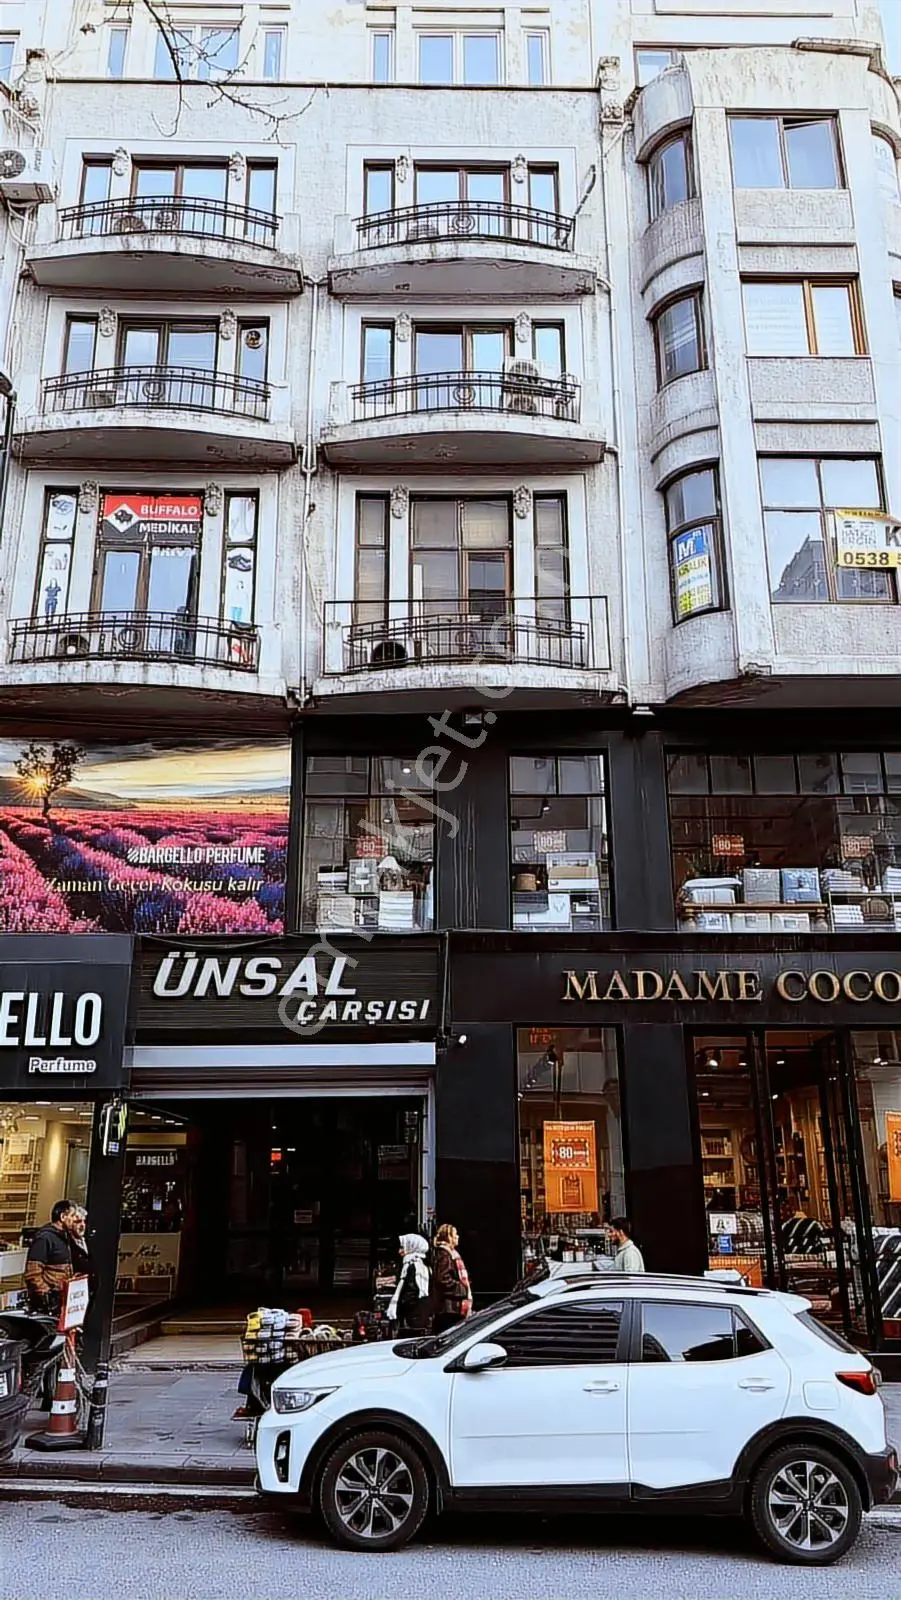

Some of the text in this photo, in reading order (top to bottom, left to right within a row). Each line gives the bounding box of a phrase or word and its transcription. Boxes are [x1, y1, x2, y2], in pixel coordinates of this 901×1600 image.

[140, 504, 198, 516] BUFFALO
[139, 521, 197, 534] MEDİKAL
[843, 551, 890, 566] 0538
[139, 847, 266, 864] BARGELLO PERFUME
[160, 876, 223, 892] Kokusu
[153, 951, 357, 997] ÜNSAL
[562, 970, 901, 1002] MADAME COCO
[0, 992, 102, 1046] ELLO
[296, 999, 430, 1025] ÇARŞISI
[28, 1056, 97, 1073] Perfume
[559, 1146, 573, 1159] 80
